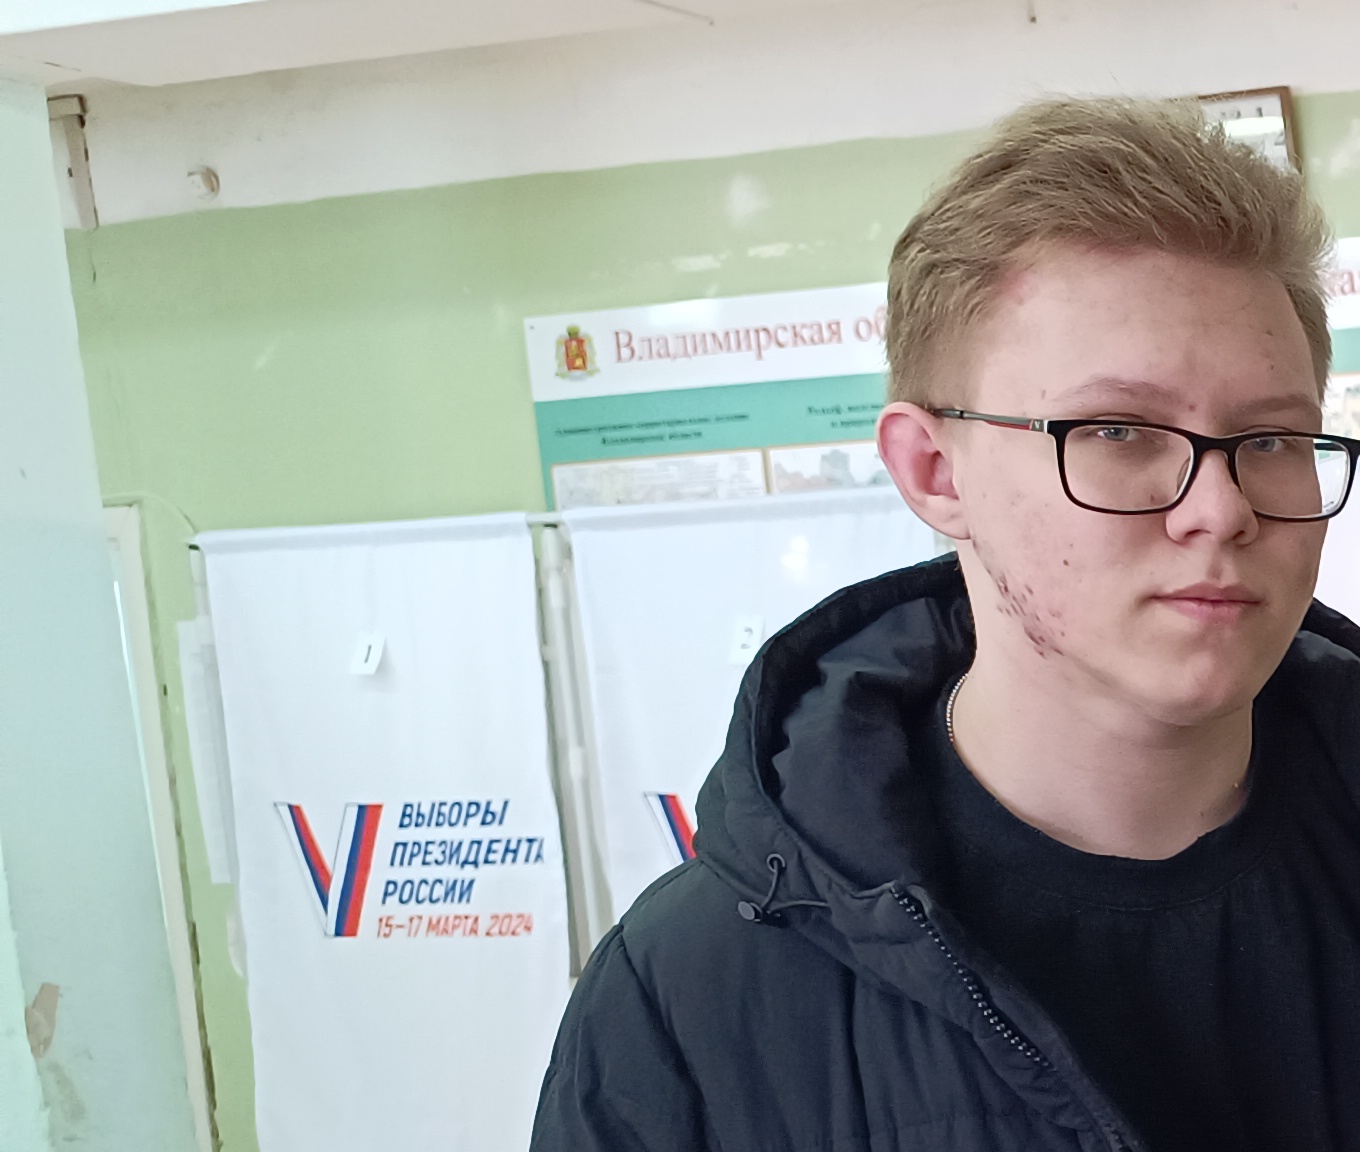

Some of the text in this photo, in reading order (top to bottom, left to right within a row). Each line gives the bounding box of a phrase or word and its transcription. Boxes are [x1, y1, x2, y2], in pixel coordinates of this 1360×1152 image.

[612, 317, 843, 365] Владимирская
[398, 799, 511, 829] ВЫБОРЫ
[389, 837, 545, 869] ПРЕЗИДЕНТА
[381, 878, 476, 905] РОССИИ
[425, 914, 480, 938] МАРТА
[485, 911, 534, 938] 2024
